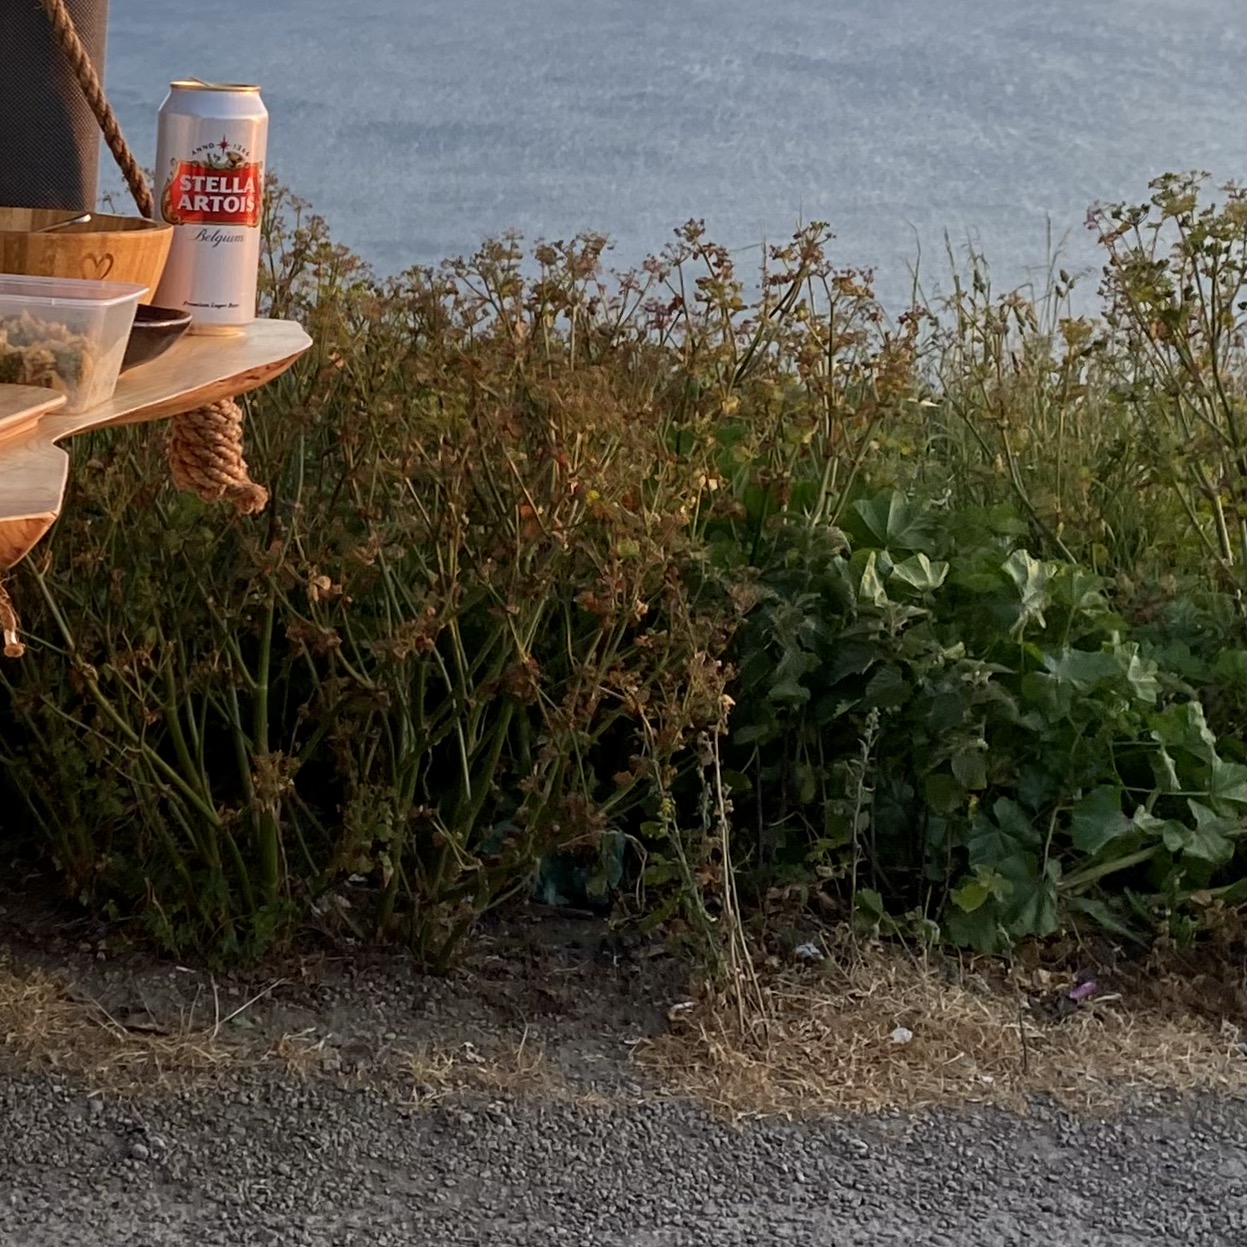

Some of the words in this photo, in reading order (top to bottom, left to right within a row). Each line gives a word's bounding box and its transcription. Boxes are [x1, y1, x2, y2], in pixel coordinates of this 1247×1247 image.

[192, 143, 214, 155] ANNO
[180, 174, 255, 193] STELLA
[177, 194, 255, 213] ARTOIS
[191, 229, 244, 248] Belgium
